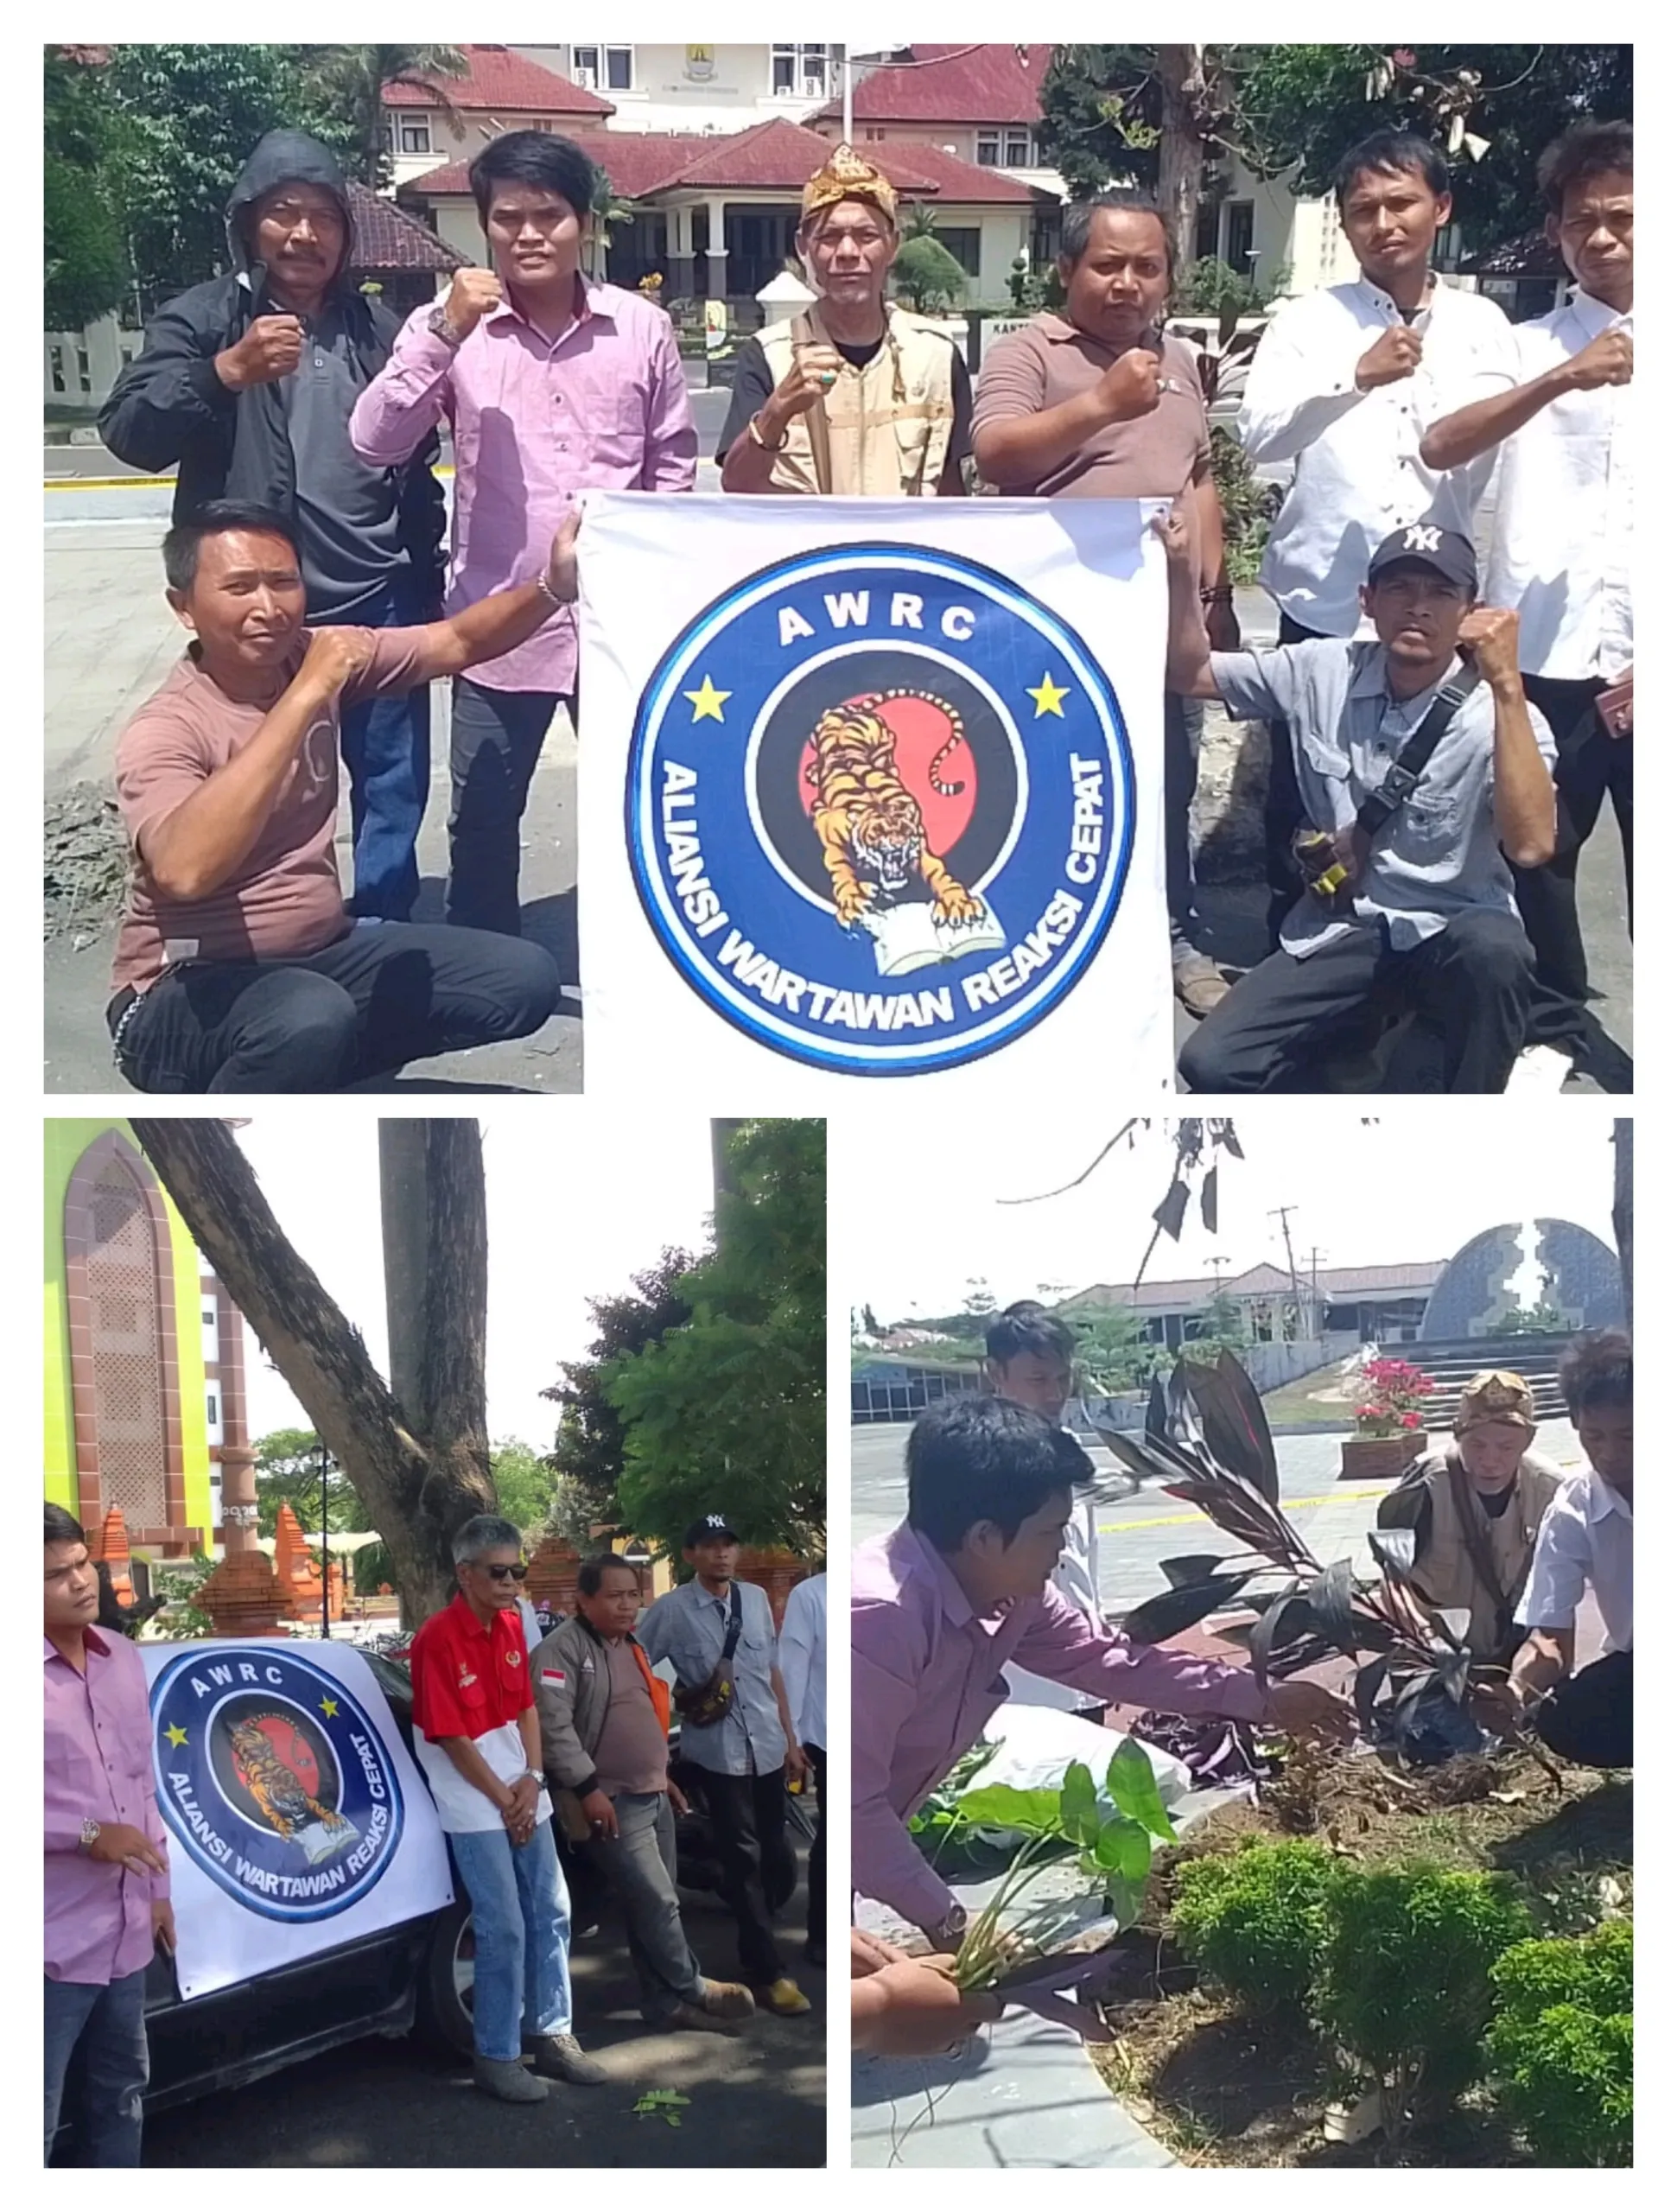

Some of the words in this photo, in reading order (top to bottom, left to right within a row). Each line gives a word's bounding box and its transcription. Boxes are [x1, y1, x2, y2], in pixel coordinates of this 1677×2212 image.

[1402, 524, 1443, 552] NY
[778, 590, 976, 646] AWRC
[662, 759, 729, 938] ALIANSI
[715, 927, 956, 1031] WARTAWAN
[961, 886, 1083, 1012] REAKSI
[1066, 752, 1104, 886] CEPAT
[190, 1662, 283, 1698] AWRC
[349, 1732, 385, 1800] CEPAT
[168, 1771, 234, 1865] ALIANSI
[347, 1803, 388, 1876] REAKSI
[234, 1855, 346, 1898] WARTAWAN
